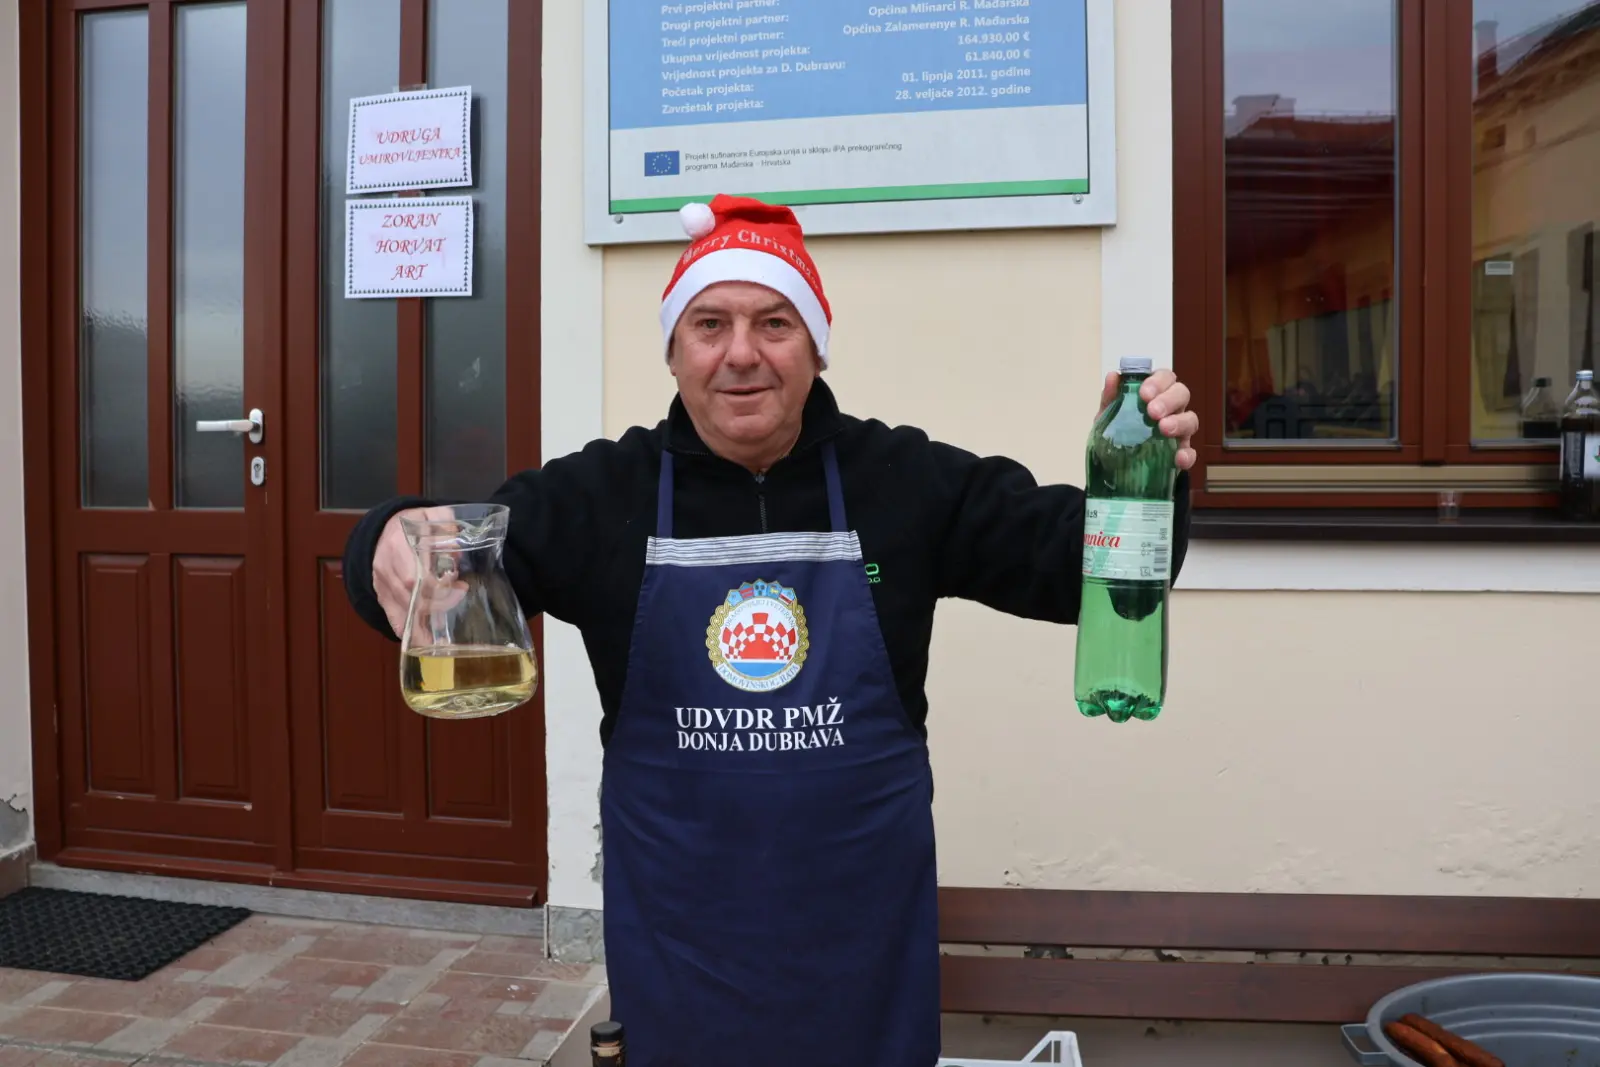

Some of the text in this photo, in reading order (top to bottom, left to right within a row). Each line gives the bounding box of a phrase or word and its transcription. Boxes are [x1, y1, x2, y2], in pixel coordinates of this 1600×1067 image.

[662, 0, 780, 14] Prvi projektni partner:
[868, 5, 908, 17] Općina
[910, 1, 956, 13] Mlinarci
[960, 1, 970, 10] R.
[662, 15, 789, 32] Drugi projektni partner:
[843, 14, 1030, 36] Općina Zalamerenye R. Mađarska
[662, 32, 784, 48] Treći projektni partner:
[1022, 31, 1031, 41] €
[662, 46, 811, 65] Ukupna vrijednost projekta:
[1023, 48, 1032, 58] €
[662, 60, 846, 82] Vrijednost projekta za D. Dubravu:
[902, 66, 1031, 84] 01. lipnja 2011. godine
[662, 84, 754, 97] Početak projekta:
[896, 84, 1031, 101] 28. veljače 2012. godine
[662, 99, 764, 114] Završetak projekta:
[376, 128, 441, 144] UDRUGA
[359, 148, 462, 165] UMIROVLJENIKA
[685, 152, 708, 160] Projekt
[749, 149, 782, 158] Europska
[784, 148, 800, 156] unija
[808, 146, 831, 154] sklopu
[685, 163, 718, 172] programa
[382, 212, 441, 229] ZORAN
[375, 238, 446, 255] HORVAT
[682, 234, 732, 264] Merry
[390, 264, 428, 280] ART
[675, 696, 844, 730] UDVDR PMŽ
[677, 728, 844, 751] DONJA DUBRAVA
